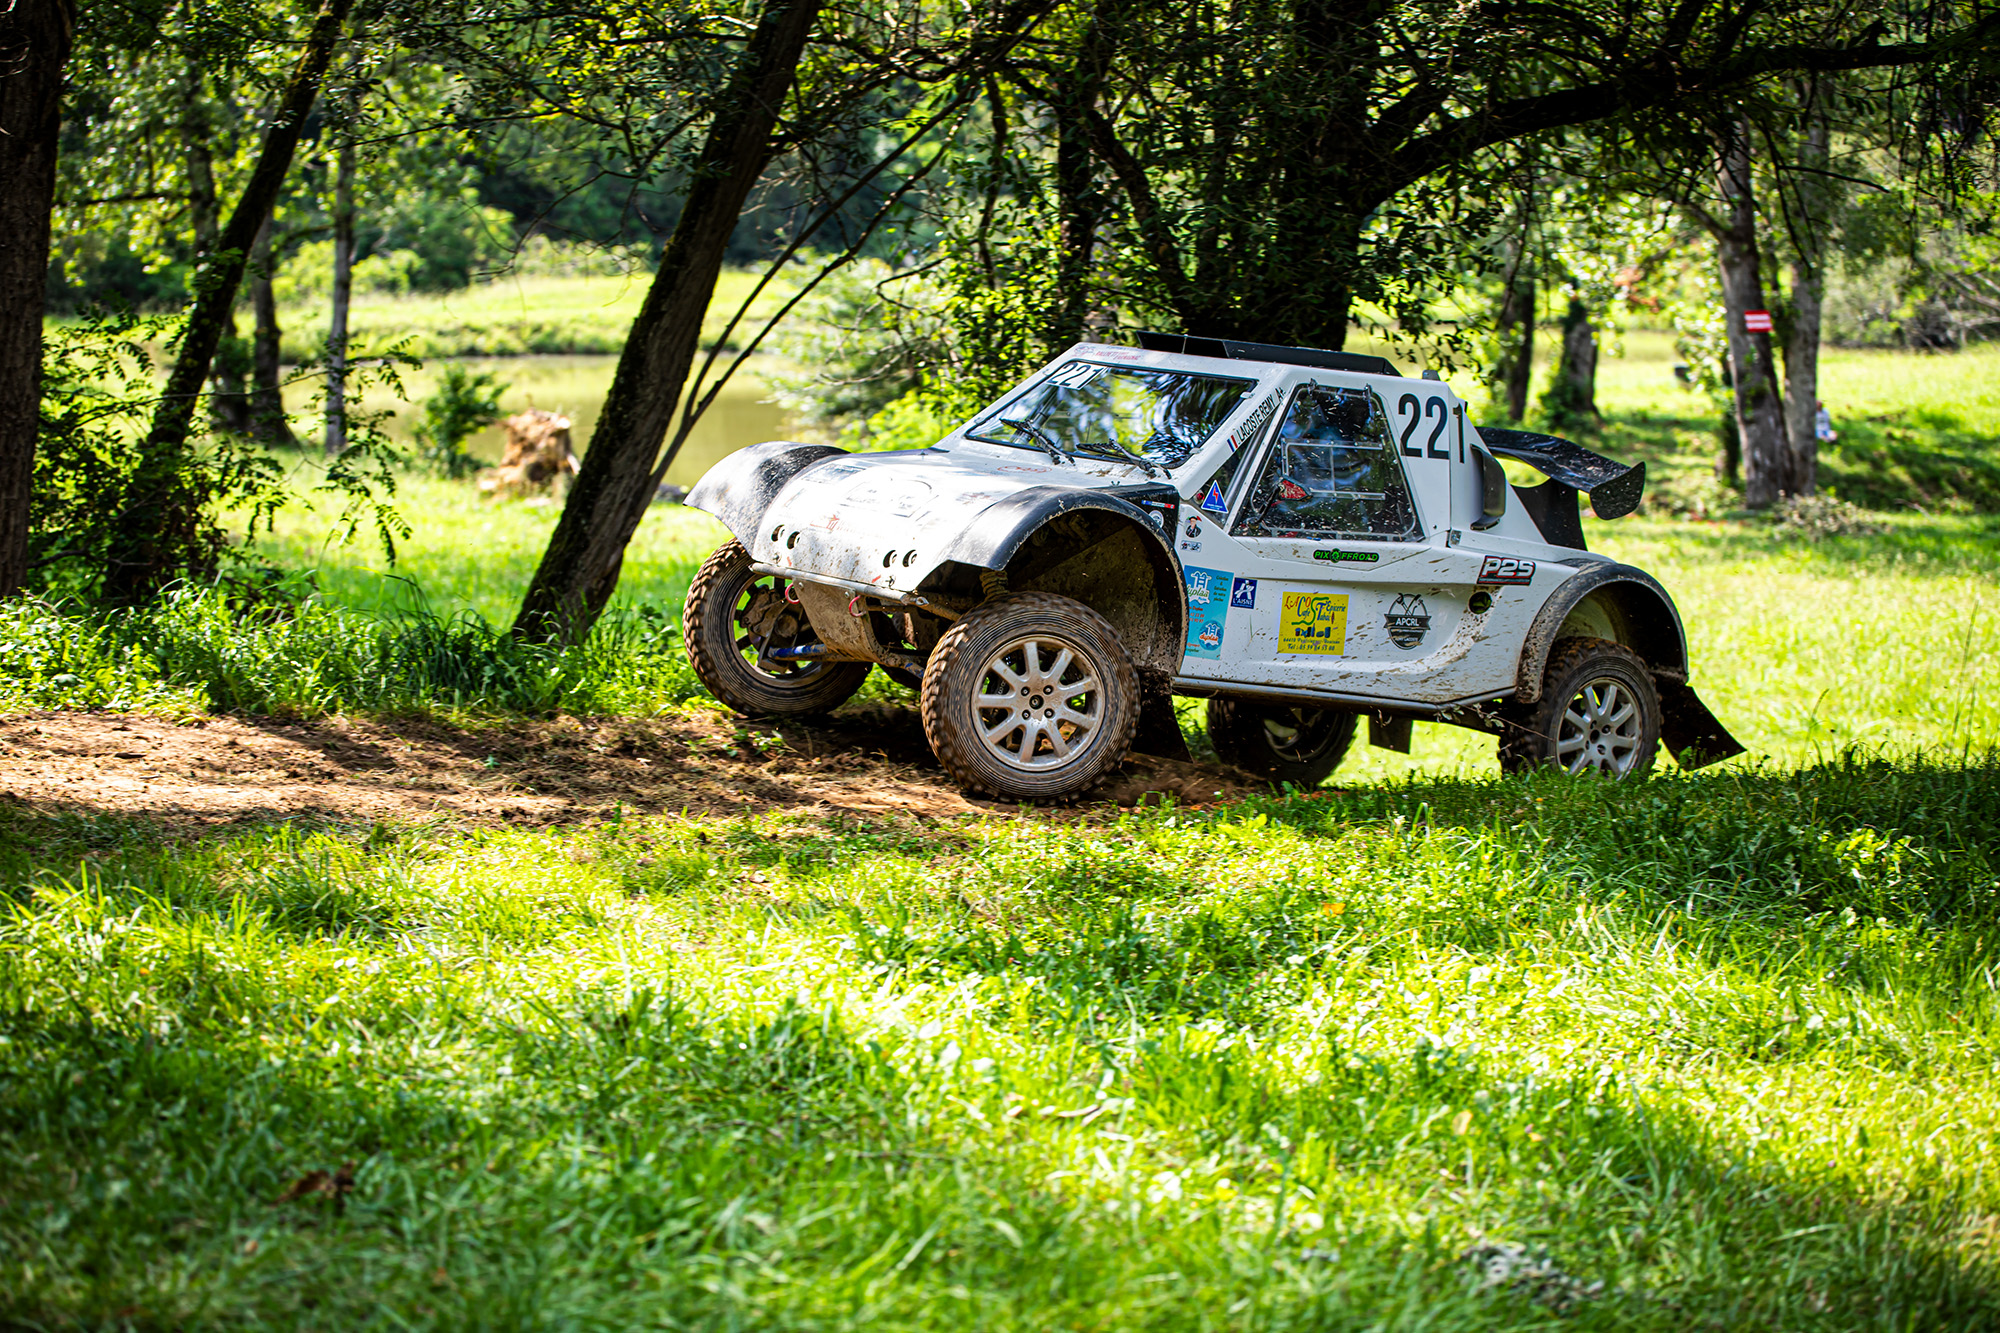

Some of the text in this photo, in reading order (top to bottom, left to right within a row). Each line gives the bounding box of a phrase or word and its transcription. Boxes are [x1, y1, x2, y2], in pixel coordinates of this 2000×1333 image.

[1046, 361, 1105, 388] 221
[1236, 408, 1263, 442] LACOSTE
[1258, 394, 1276, 419] REMY
[1398, 393, 1465, 464] 221
[1395, 616, 1420, 627] APCRL
